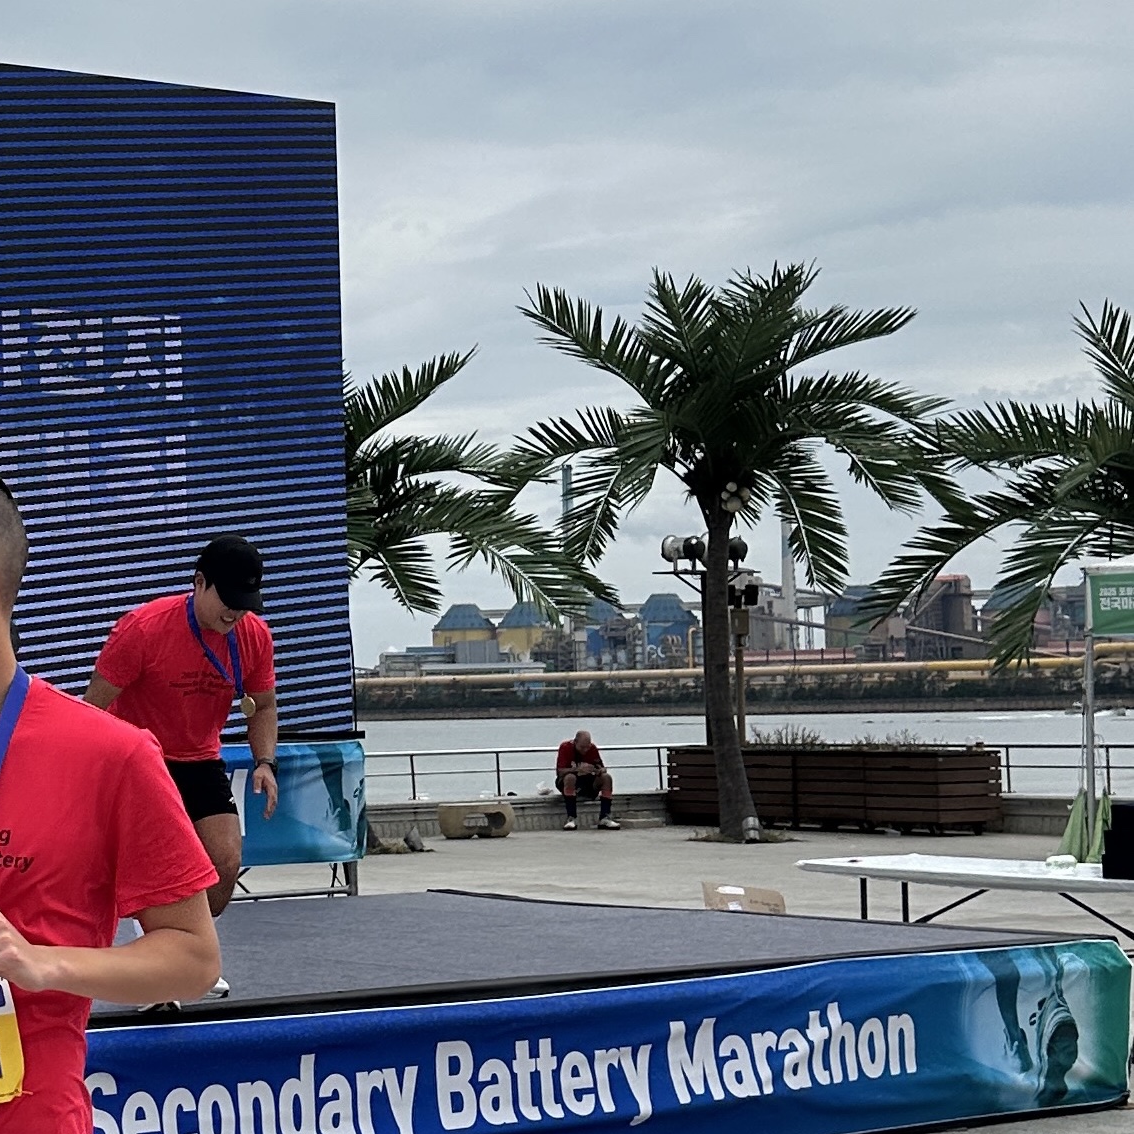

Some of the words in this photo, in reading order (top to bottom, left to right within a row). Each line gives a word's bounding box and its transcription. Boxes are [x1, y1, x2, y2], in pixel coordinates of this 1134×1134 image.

[1099, 596, 1134, 611] 전국마
[435, 1037, 652, 1131] Battery
[668, 1002, 917, 1105] Marathon
